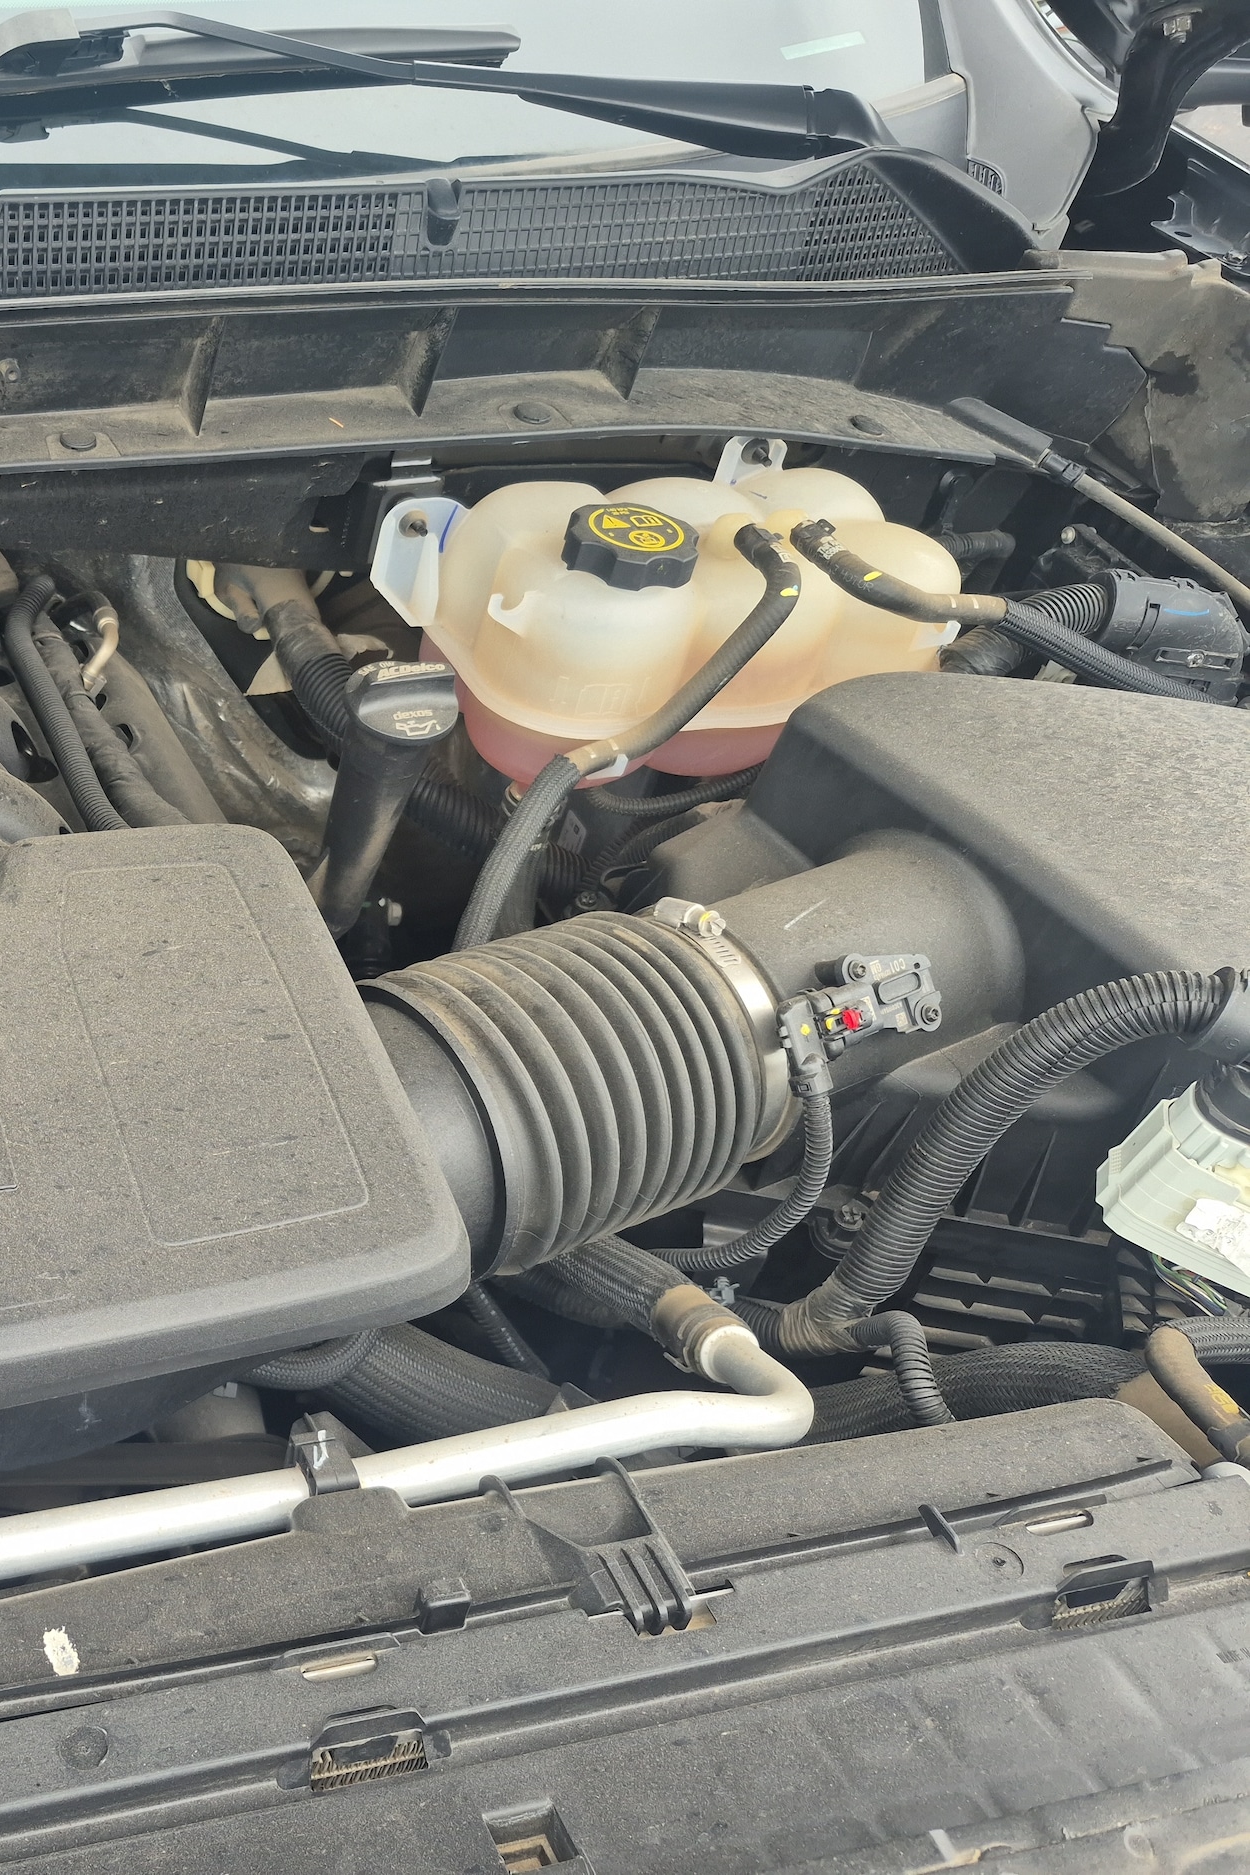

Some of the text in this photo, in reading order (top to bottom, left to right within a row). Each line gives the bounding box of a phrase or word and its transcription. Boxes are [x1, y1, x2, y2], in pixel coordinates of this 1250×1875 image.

[358, 664, 376, 676] SAE
[377, 663, 446, 680] ACDelco
[393, 709, 434, 720] dexos
